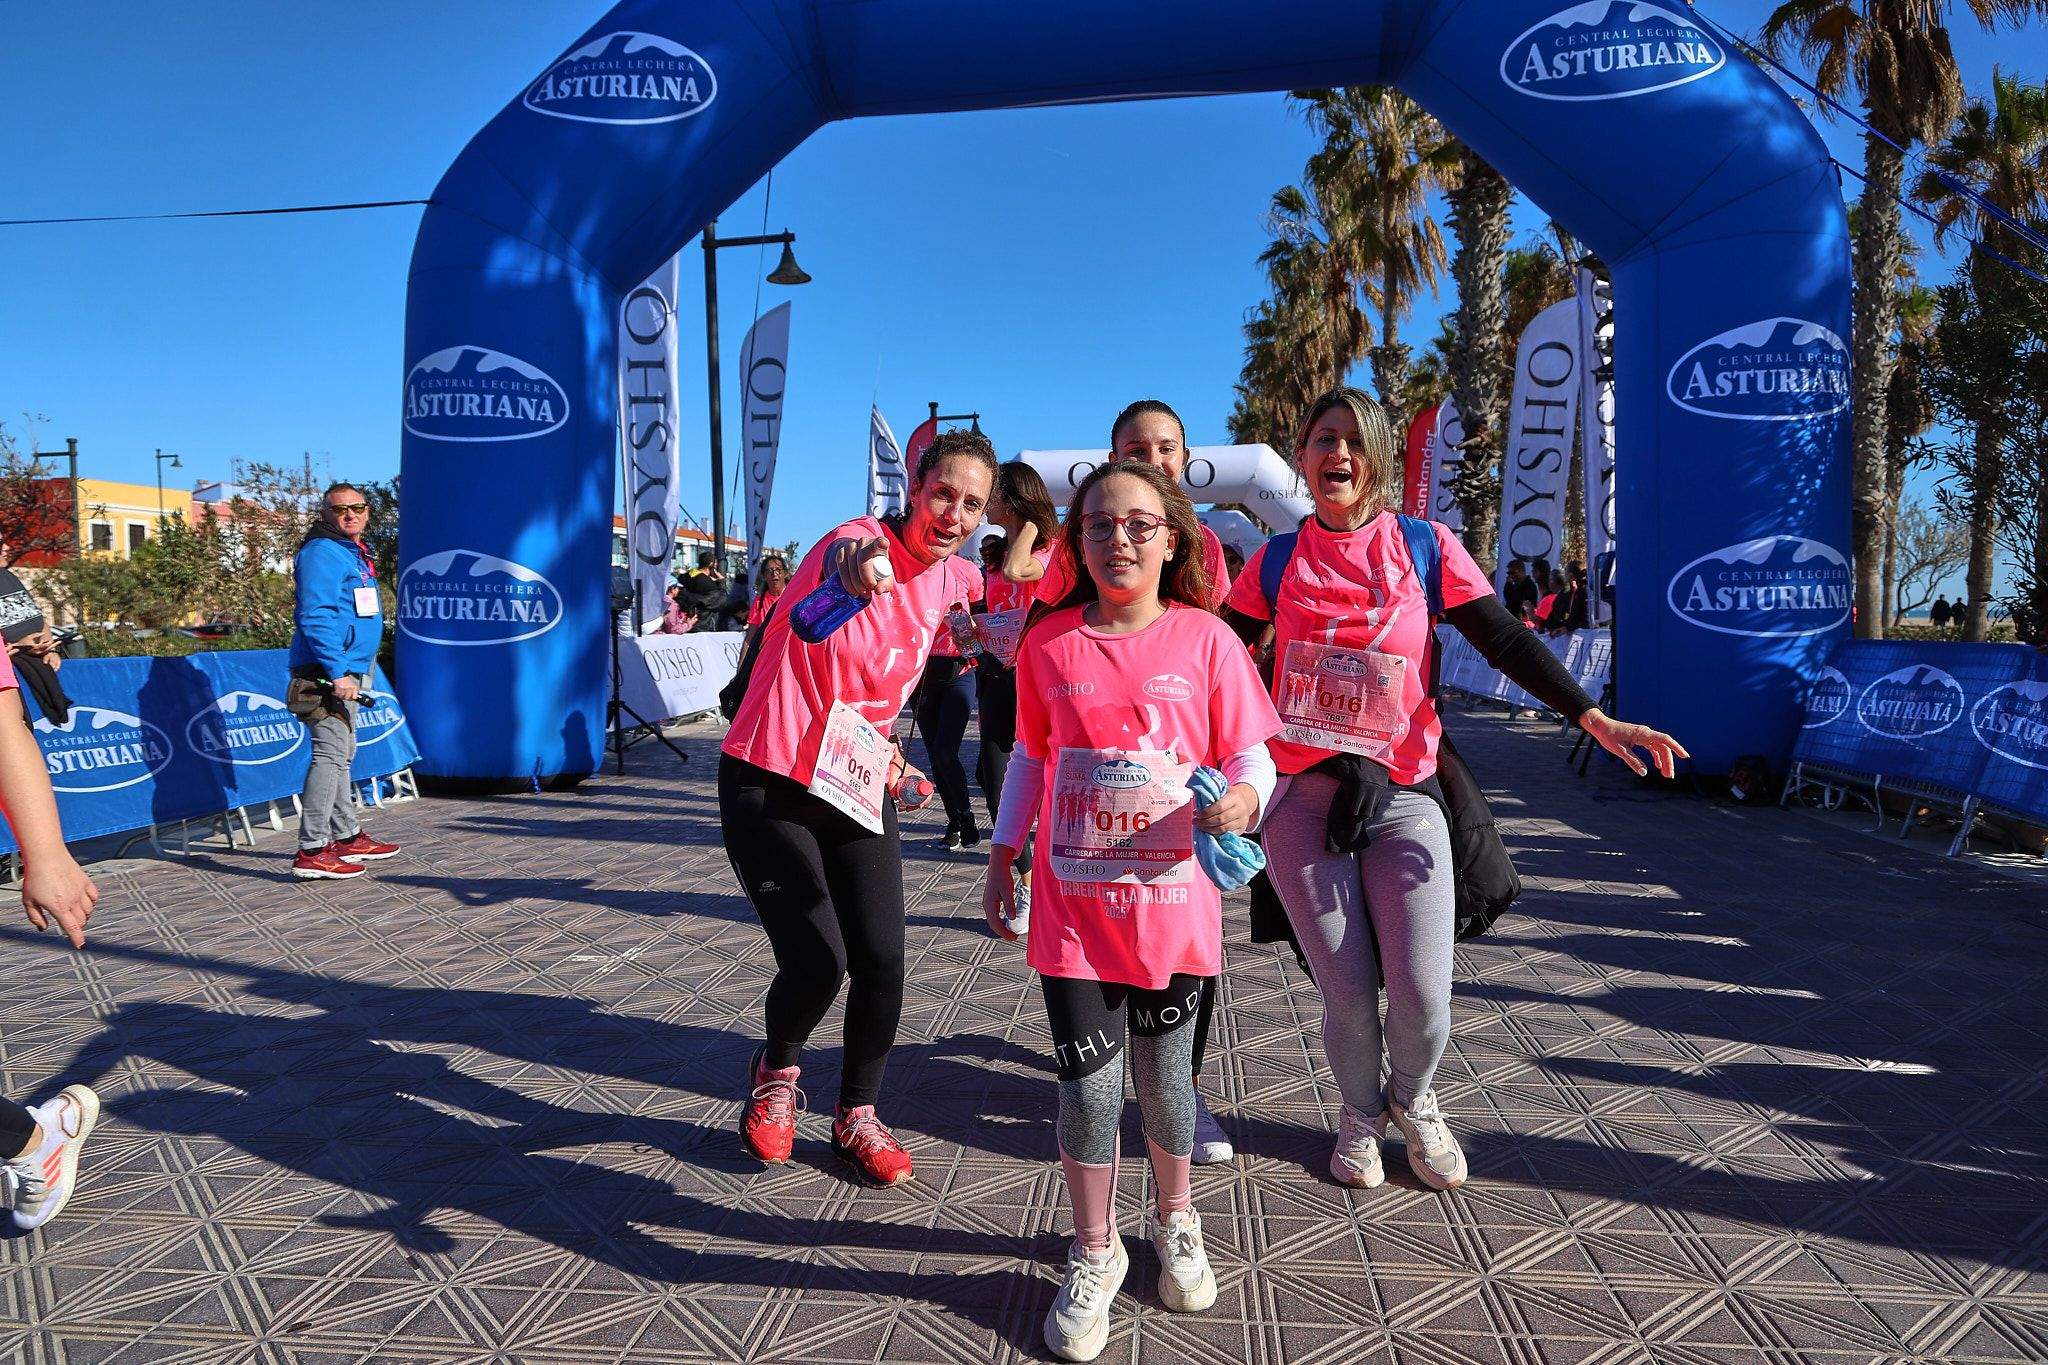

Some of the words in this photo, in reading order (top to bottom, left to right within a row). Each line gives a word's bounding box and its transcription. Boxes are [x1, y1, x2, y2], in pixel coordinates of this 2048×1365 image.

[1555, 30, 1630, 47] CENTRAL
[1637, 28, 1701, 40] LECHERA
[564, 60, 622, 75] CENTRAL
[628, 59, 695, 72] LECHERA
[1518, 41, 1716, 84] ASTURIANA
[532, 74, 702, 103] ASTURIANA
[1718, 353, 1792, 366] CENTRAL
[420, 378, 475, 389] CENTRAL
[481, 379, 550, 395] LECHERA
[1682, 361, 1848, 400] ASTURIANA
[405, 384, 556, 423] ASTURIANA
[624, 287, 670, 566] OYSHO
[1509, 341, 1574, 563] OYSHO
[1718, 570, 1792, 581] CENTRAL
[414, 582, 469, 592] CENTRAL
[475, 583, 543, 595] LECHERA
[1682, 574, 1848, 611] ASTURIANA
[400, 584, 549, 623] ASTURIANA
[643, 646, 704, 682] OYSHO
[1324, 660, 1364, 675] ASTURIANA
[1563, 640, 1612, 678] OYSH
[1048, 682, 1095, 700] OYSHO
[1319, 691, 1362, 713] 016
[1861, 690, 1953, 722] ASTURIANA
[356, 707, 401, 729] RIANA
[1289, 716, 1314, 727] CARRERA
[1322, 722, 1330, 730] LA
[1330, 723, 1349, 733] MUJER
[1353, 728, 1378, 738] VALENCIA
[44, 736, 99, 748] CENTRAL
[101, 730, 144, 742] LECHER
[202, 721, 299, 752] ASTURIANA
[1285, 727, 1321, 741] OYSHO
[1342, 739, 1378, 751] Santander
[47, 741, 166, 774] STURIANA
[848, 758, 871, 786] 016
[1095, 769, 1148, 782] ASTURIANA
[1095, 810, 1150, 833] 016
[1105, 838, 1132, 848] 5162
[1064, 848, 1093, 858] CARRERA
[1094, 850, 1103, 858] DE
[1115, 851, 1139, 859] MUJER
[1144, 851, 1176, 859] VALENCIA
[1061, 862, 1106, 875] OYSHO
[1134, 866, 1178, 877] Santander
[1122, 886, 1136, 904] LA
[1142, 887, 1189, 904] MUJER
[1105, 906, 1127, 919] 2025
